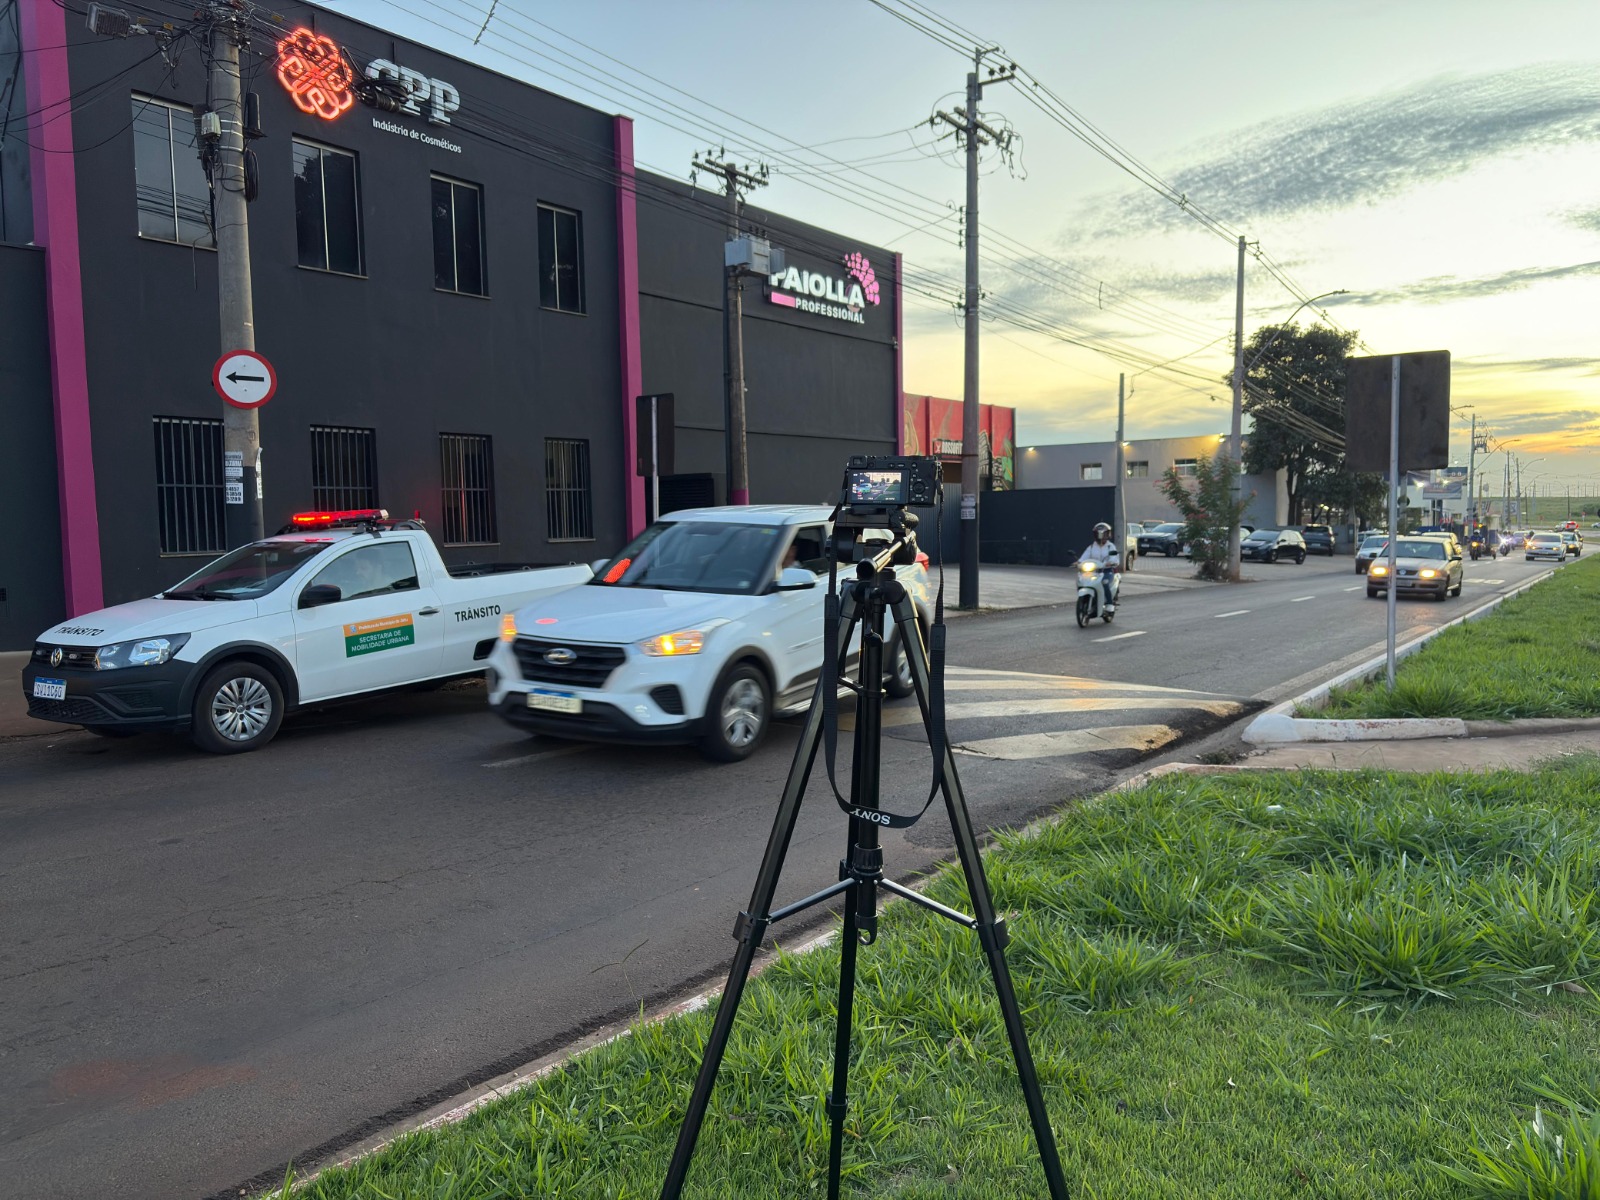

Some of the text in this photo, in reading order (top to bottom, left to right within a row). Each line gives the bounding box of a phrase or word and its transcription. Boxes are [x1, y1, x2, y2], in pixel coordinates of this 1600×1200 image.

[372, 117, 462, 153] Indústria de Cosméticos
[769, 266, 865, 308] PAIOLLA
[795, 297, 865, 324] PROFESSIONAL
[455, 604, 501, 623] TRÂNSITO
[351, 635, 409, 652] MOBILIDADE URBANA
[359, 631, 393, 643] SECRETARIA
[850, 809, 890, 825] SONY
